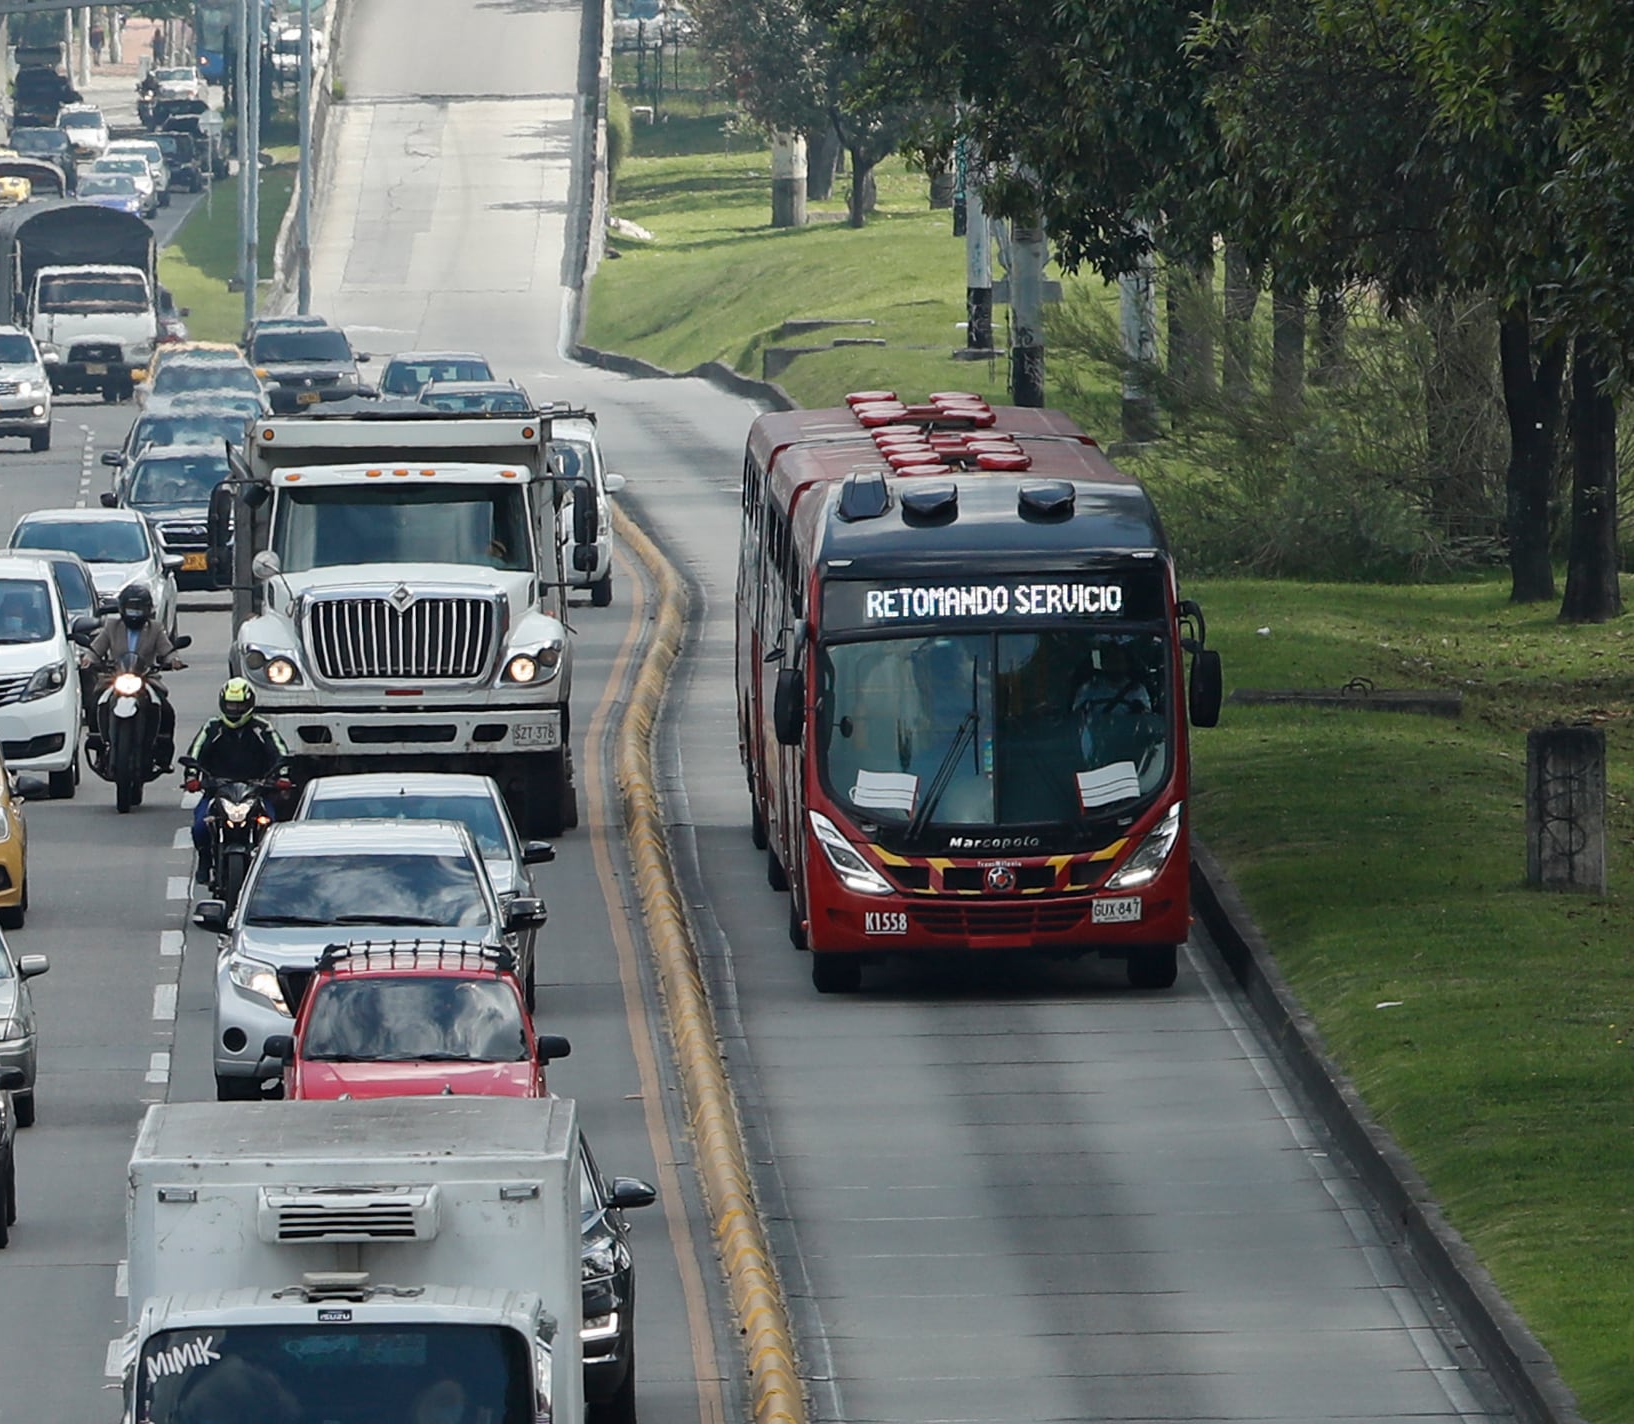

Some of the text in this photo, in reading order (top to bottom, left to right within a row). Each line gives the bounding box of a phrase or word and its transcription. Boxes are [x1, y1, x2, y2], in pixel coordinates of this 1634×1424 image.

[866, 584, 1122, 618] RETOMANDO SERVICIO
[949, 835, 1039, 848] Marcopolo
[865, 912, 908, 932] K1558
